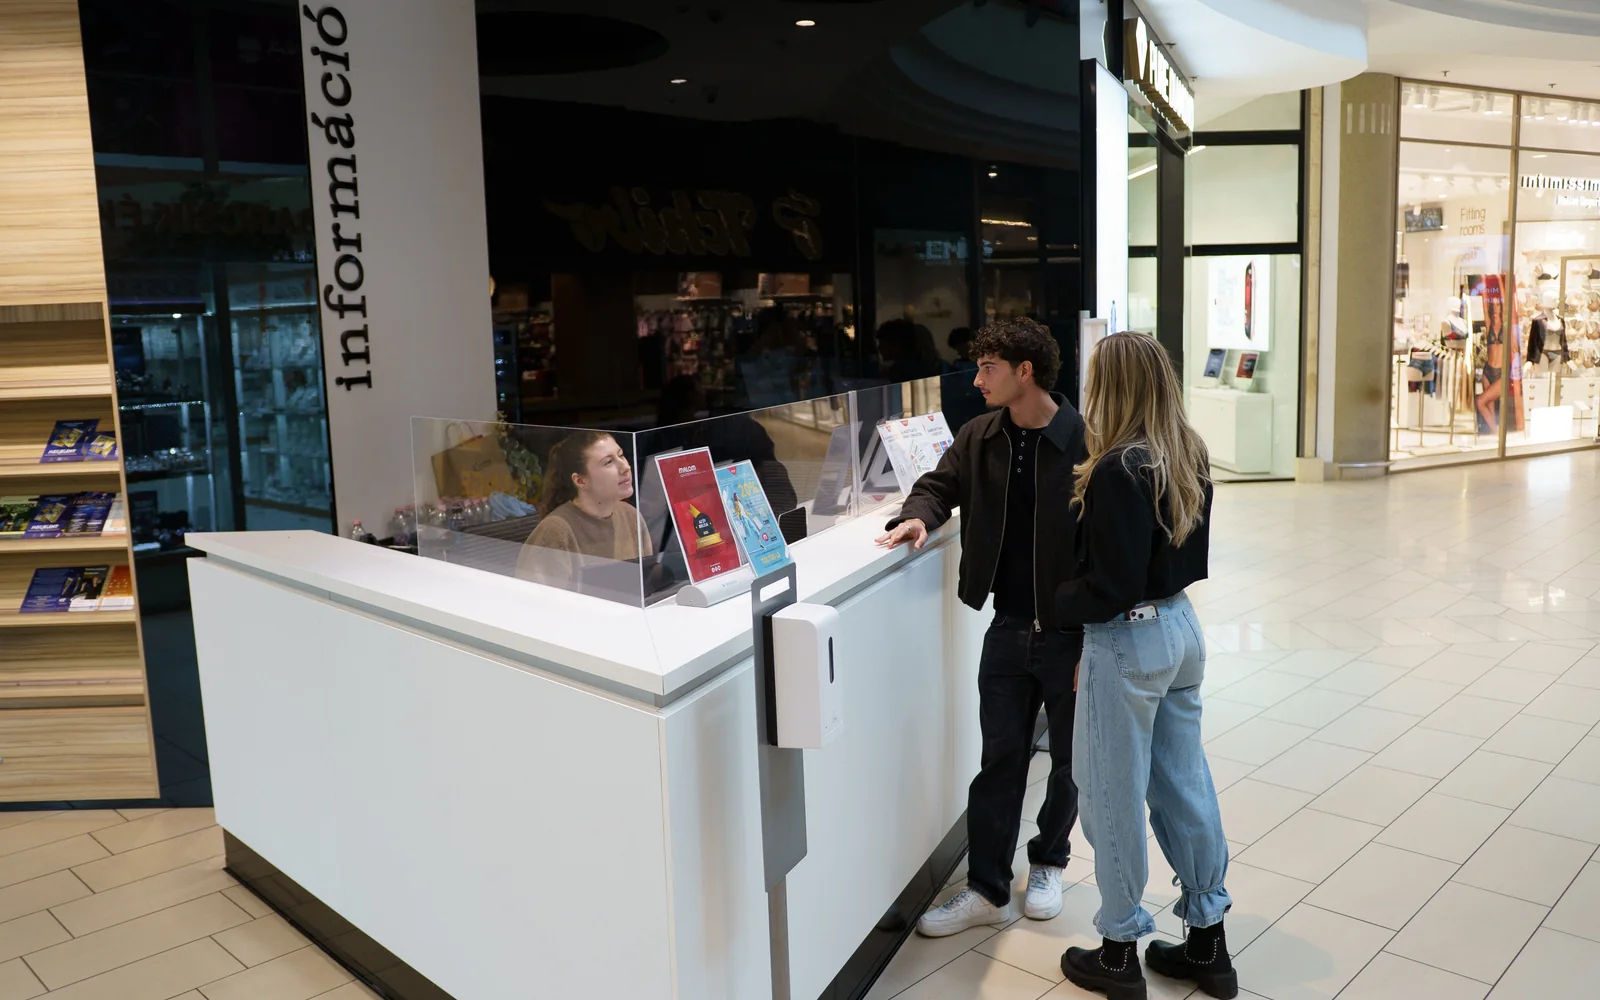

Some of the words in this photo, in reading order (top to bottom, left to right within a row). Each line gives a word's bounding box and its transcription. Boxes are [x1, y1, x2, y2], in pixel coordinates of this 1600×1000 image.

[302, 4, 374, 391] információ
[1460, 207, 1487, 222] Fitting
[1460, 224, 1486, 236] rooms
